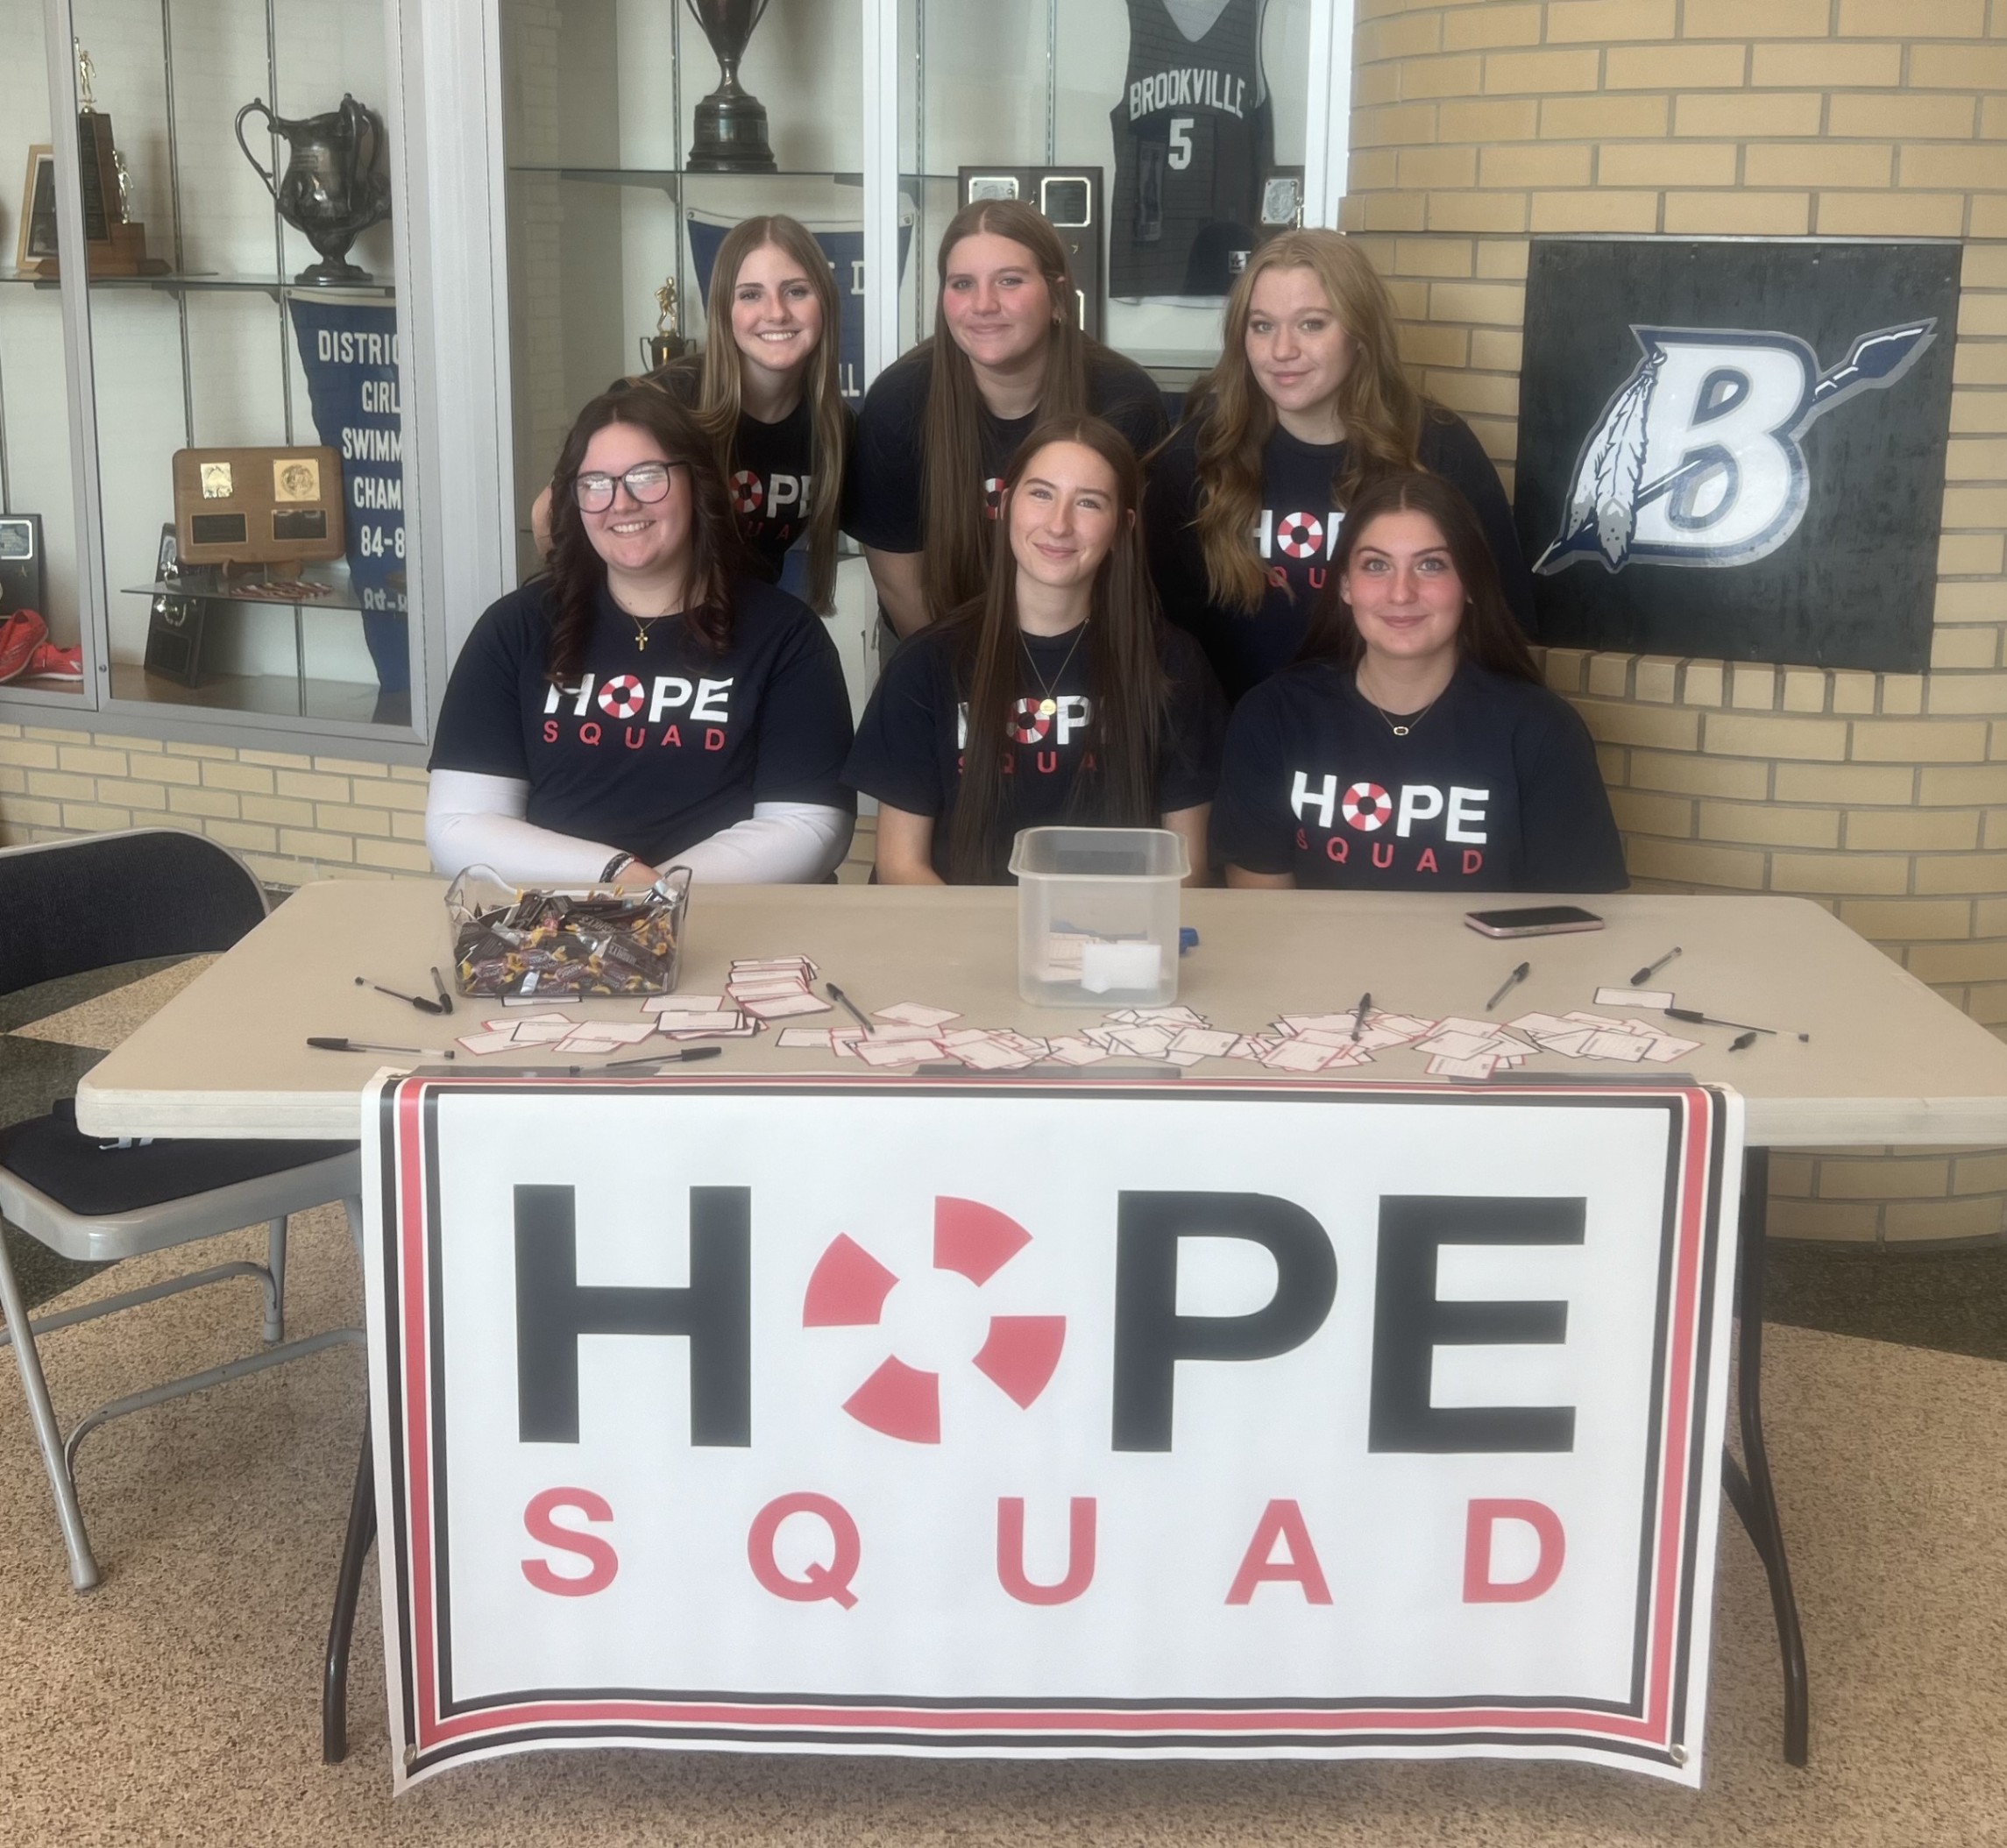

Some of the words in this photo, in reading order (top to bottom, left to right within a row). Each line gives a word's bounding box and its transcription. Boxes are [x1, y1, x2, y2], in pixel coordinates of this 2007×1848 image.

[1130, 67, 1245, 121] BROOKVILLE
[1168, 118, 1195, 170] 5
[1626, 325, 1811, 568] B
[353, 476, 402, 511] CHAM
[360, 525, 406, 559] 84-8
[543, 673, 734, 723] HOPE
[543, 720, 726, 751] SQUAD
[1290, 770, 1490, 845] HOPE
[1295, 827, 1483, 874] SQUAD
[514, 1184, 1587, 1453] HOPE
[521, 1486, 1566, 1611] SQUAD
